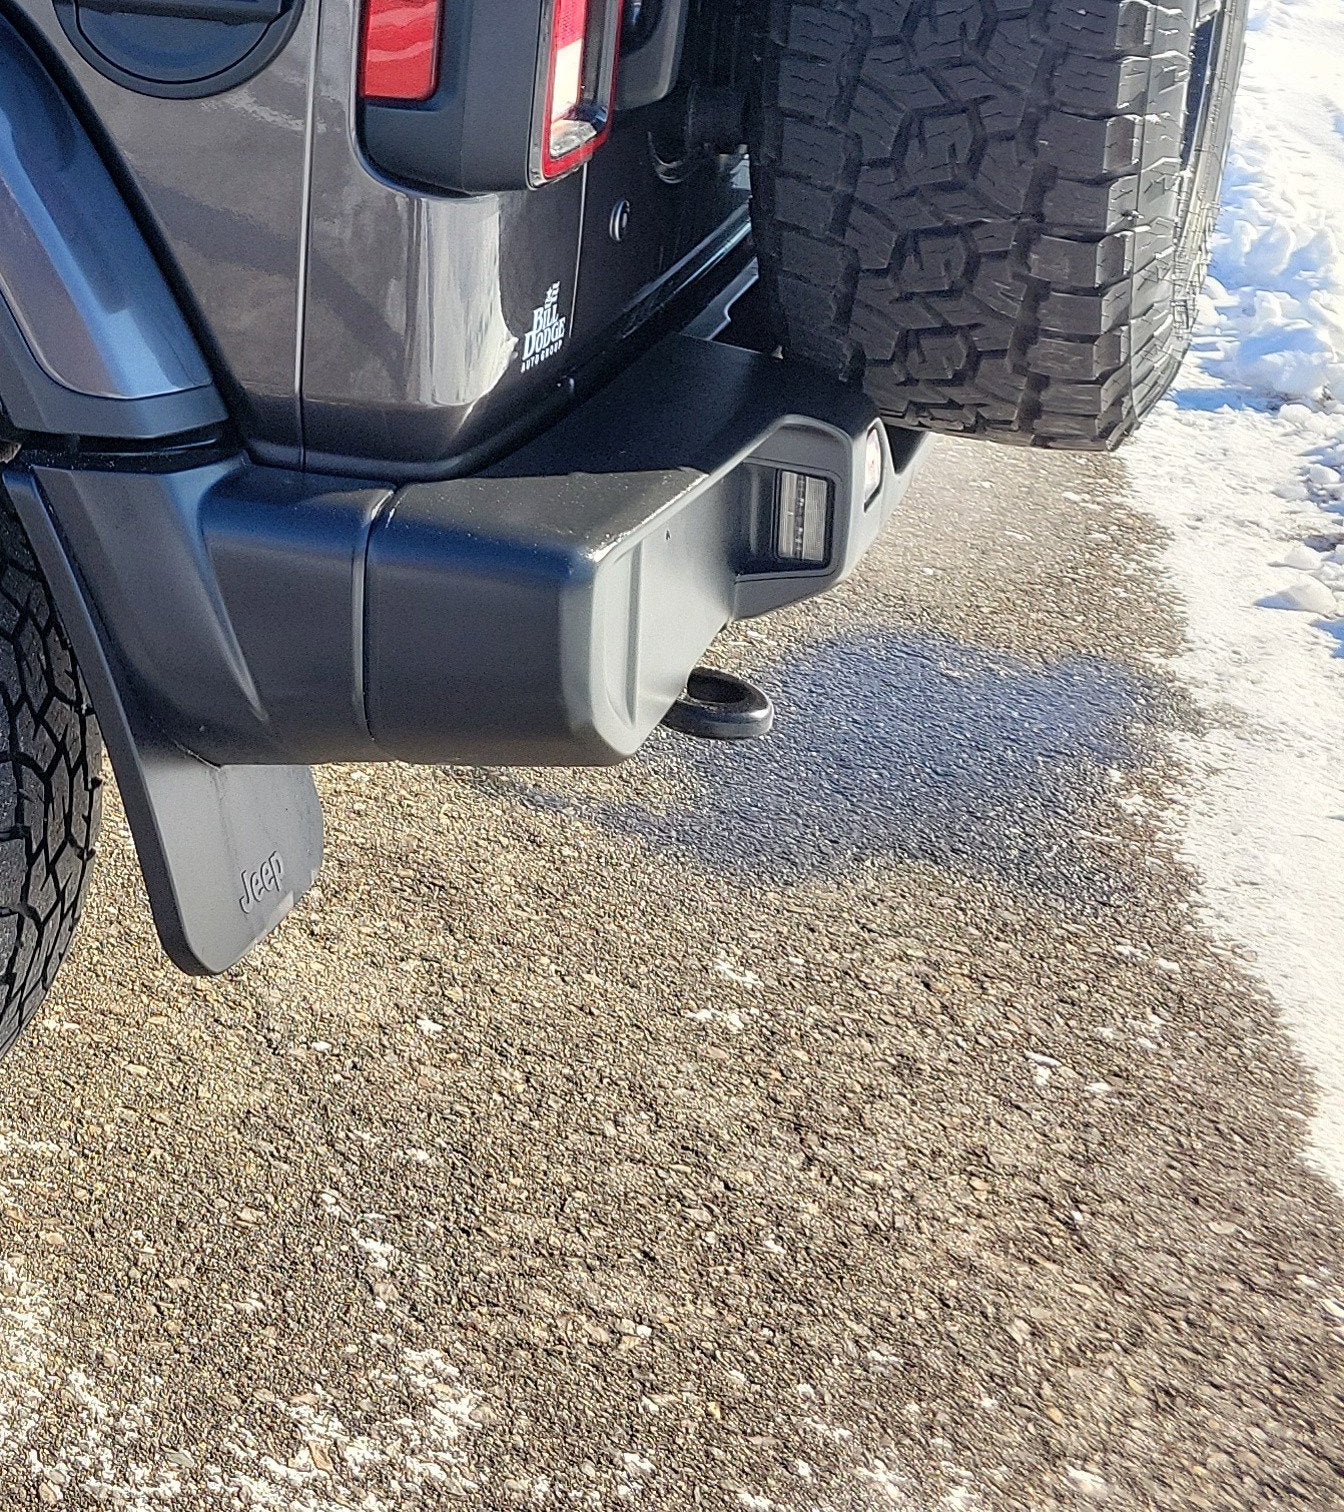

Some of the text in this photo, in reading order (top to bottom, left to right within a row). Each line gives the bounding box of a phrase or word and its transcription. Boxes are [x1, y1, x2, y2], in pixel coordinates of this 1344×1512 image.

[522, 316, 566, 361] DODGE
[533, 303, 559, 333] BILL
[238, 849, 284, 915] Jeep
